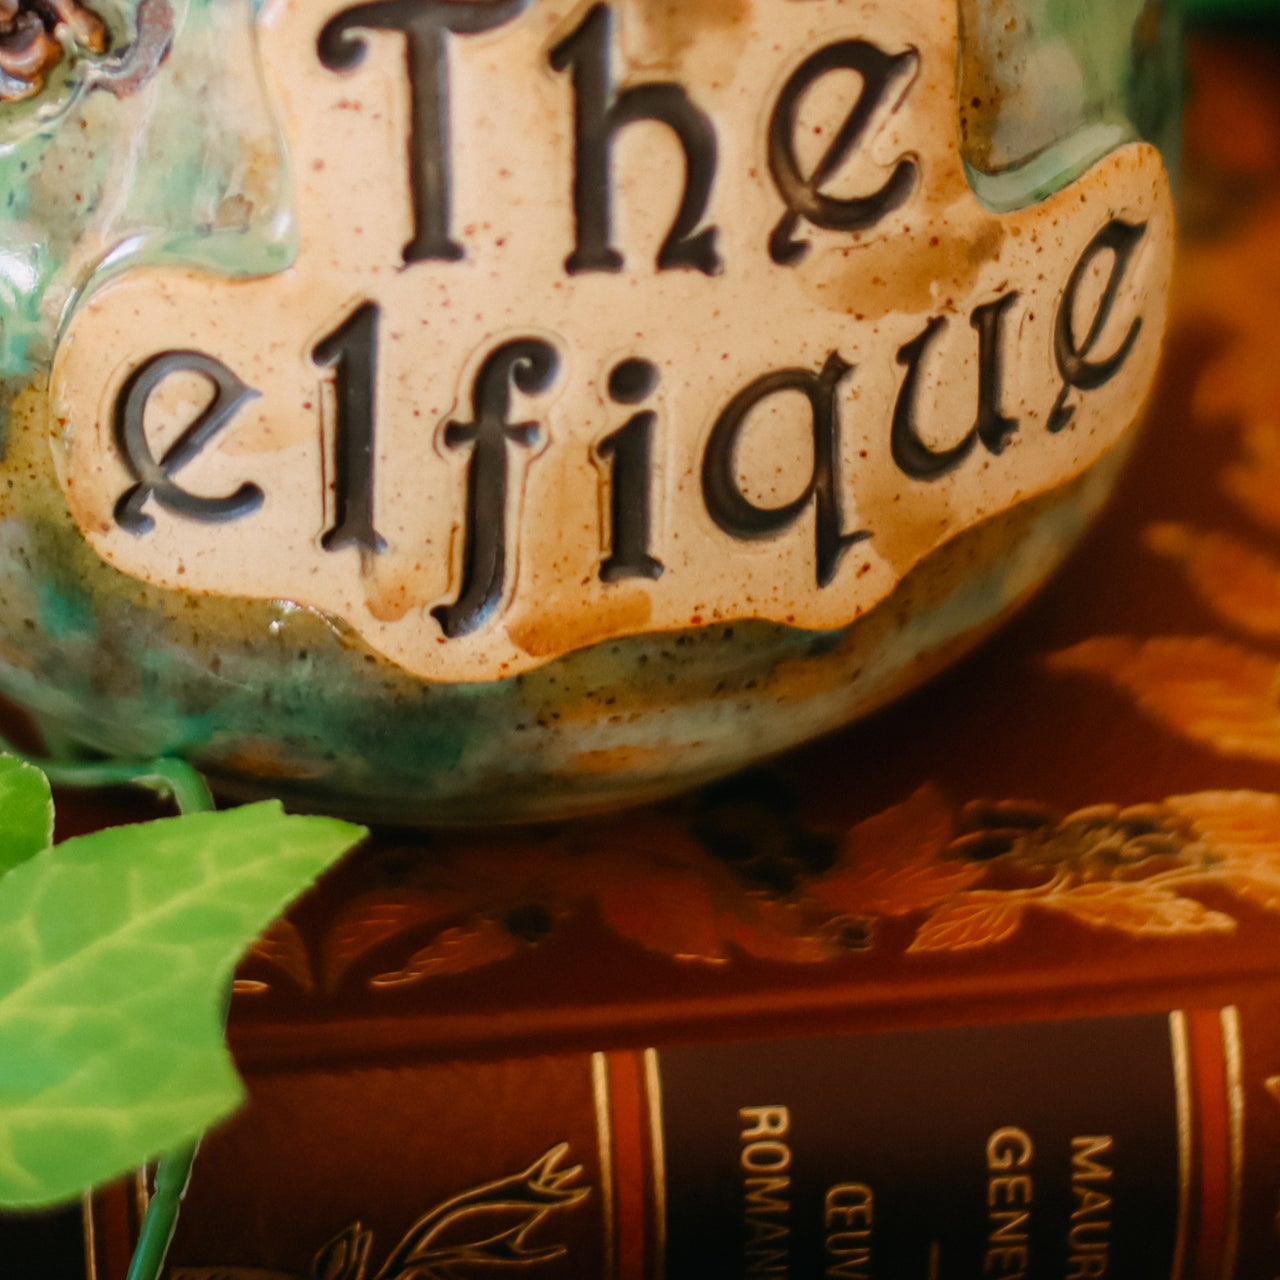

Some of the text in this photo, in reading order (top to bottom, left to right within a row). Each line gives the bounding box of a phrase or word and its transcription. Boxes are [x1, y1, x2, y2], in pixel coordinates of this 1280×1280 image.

[113, 218, 1148, 637] elfique
[739, 1105, 792, 1280] ROMAN
[985, 1126, 1034, 1280] GENE
